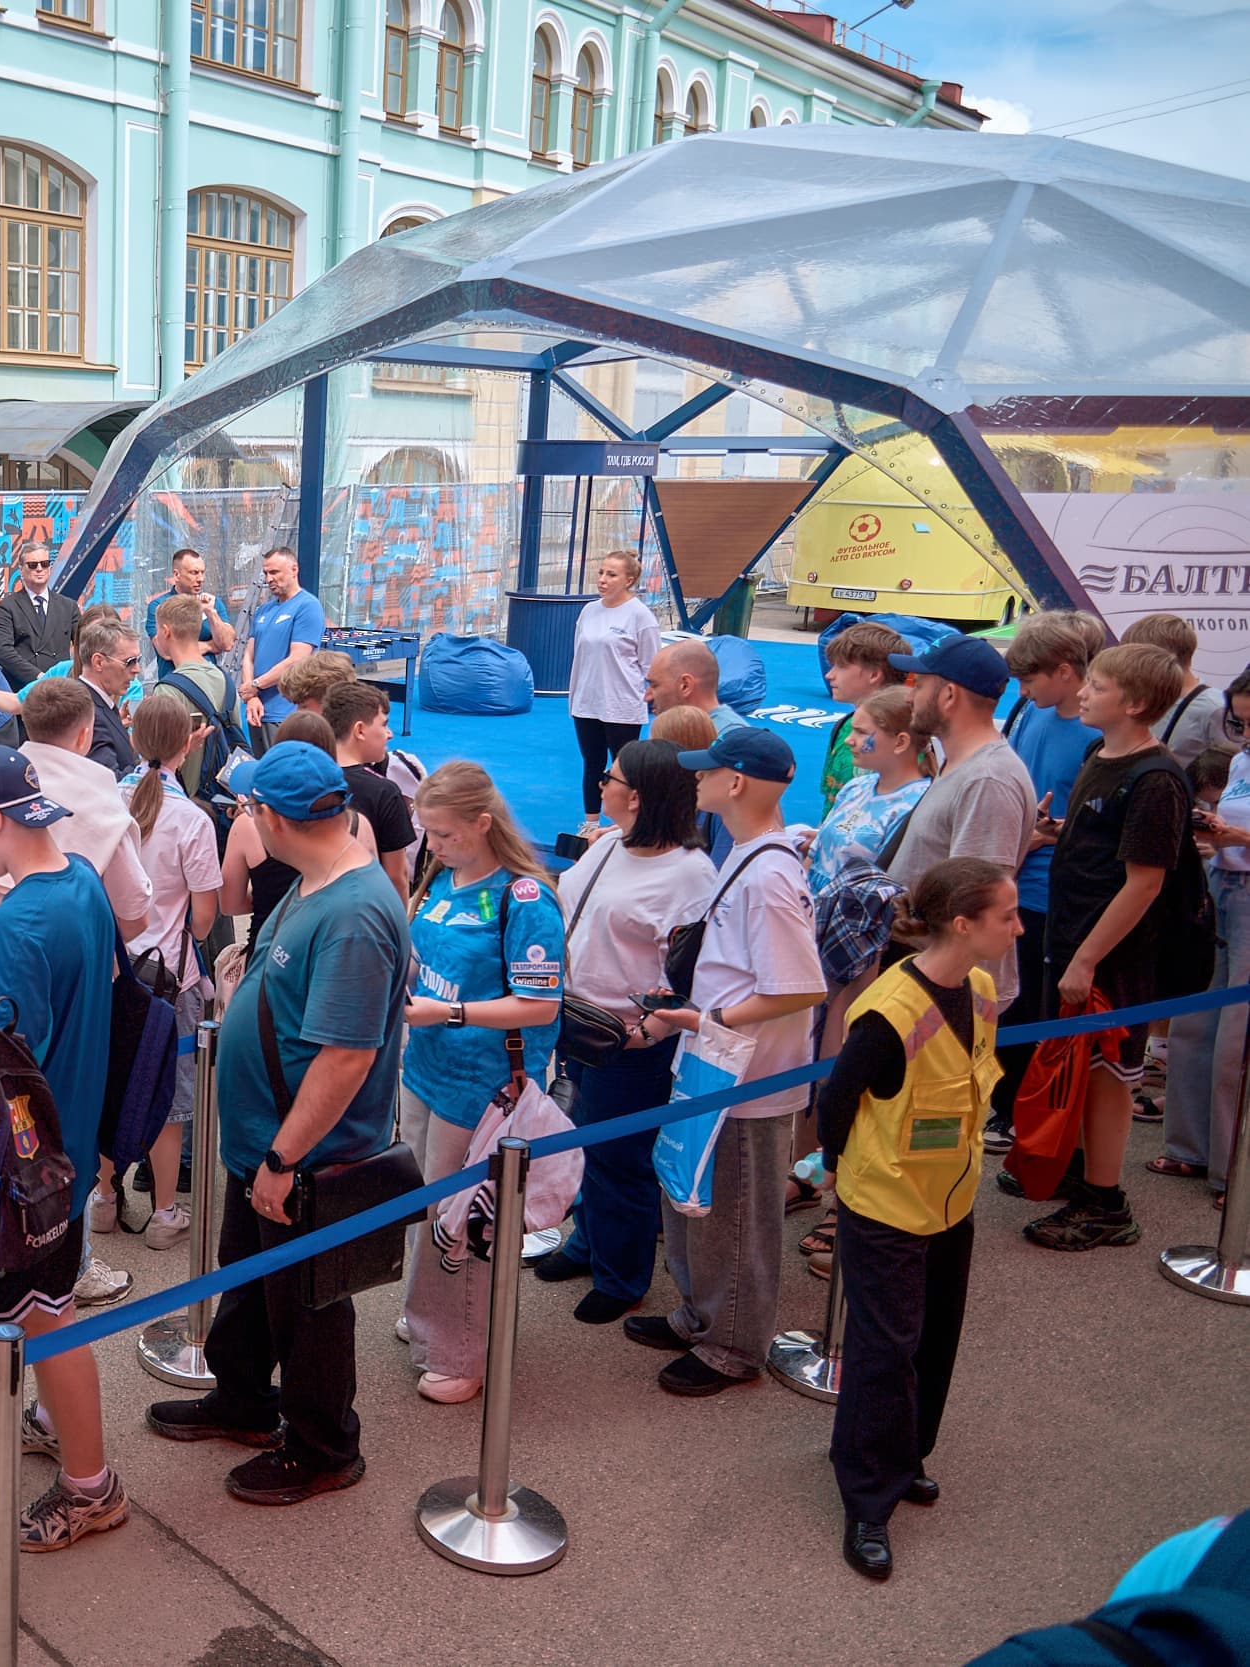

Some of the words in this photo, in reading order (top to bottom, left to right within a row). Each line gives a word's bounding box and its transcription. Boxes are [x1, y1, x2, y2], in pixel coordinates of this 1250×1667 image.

[830, 554, 849, 563] ЛЕТО
[850, 552, 861, 560] СО
[862, 547, 896, 559] ВКУСОМ
[837, 541, 891, 555] ФУТБОЛЬНОЕ
[1186, 617, 1250, 631] ЛКОГОЛ
[516, 884, 537, 896] wb
[273, 945, 291, 964] EA7
[511, 963, 560, 971] ГАЗПРОМБАНК
[515, 977, 548, 986] Winline
